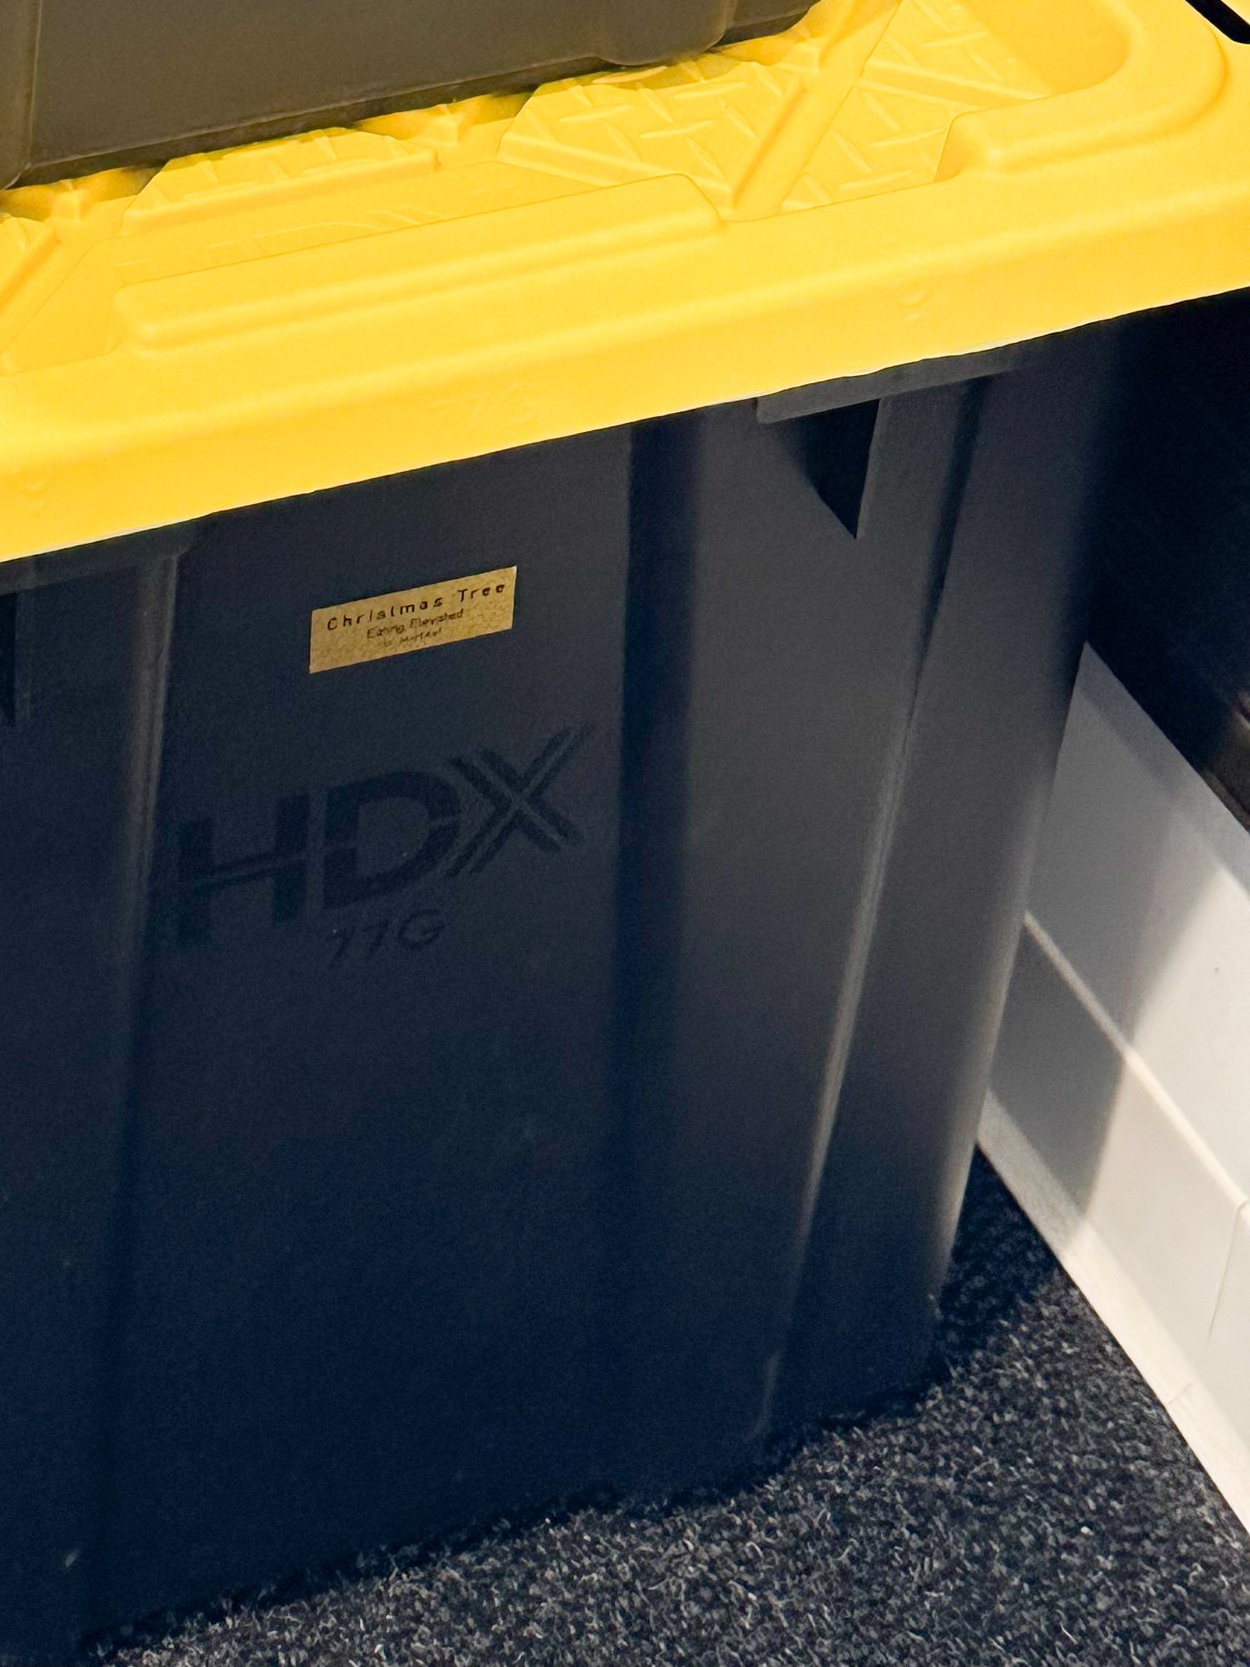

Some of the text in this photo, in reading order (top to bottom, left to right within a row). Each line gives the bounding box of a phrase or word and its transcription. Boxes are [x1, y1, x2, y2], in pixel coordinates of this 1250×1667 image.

[326, 583, 506, 631] Christmas Tree
[175, 721, 596, 948] HDX
